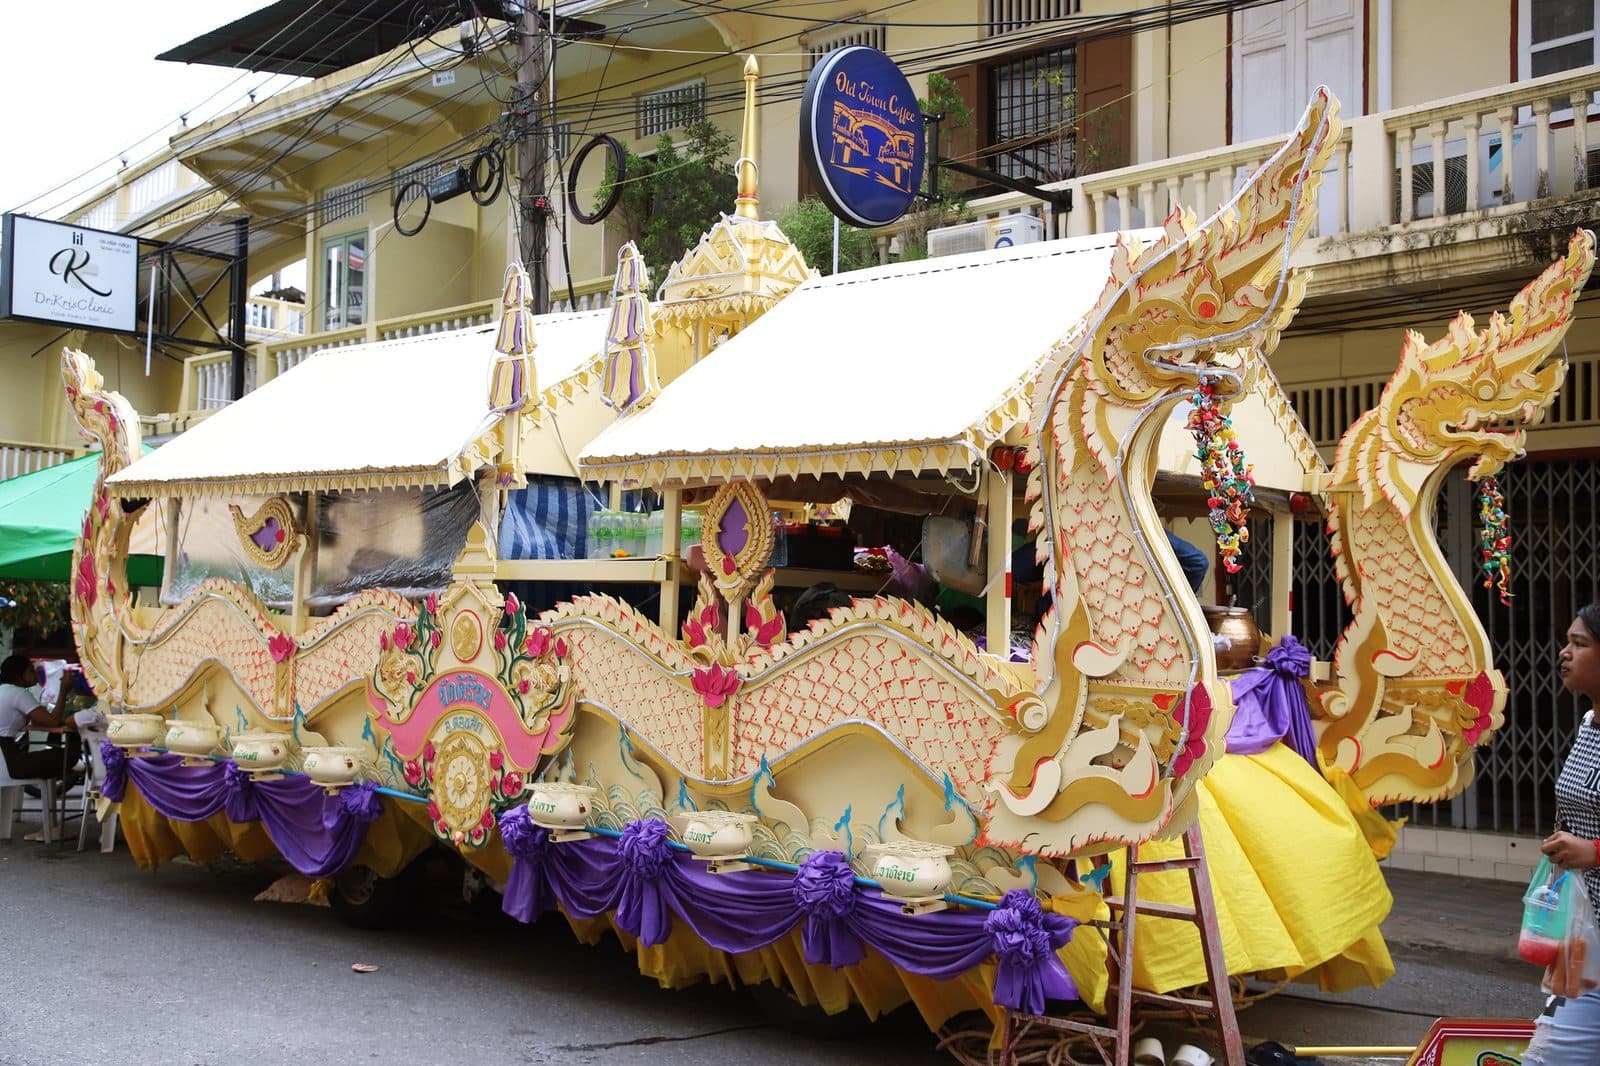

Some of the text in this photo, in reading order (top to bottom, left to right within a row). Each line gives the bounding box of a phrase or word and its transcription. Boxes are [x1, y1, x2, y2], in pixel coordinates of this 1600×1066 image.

[835, 71, 916, 125] Old Town Coffee
